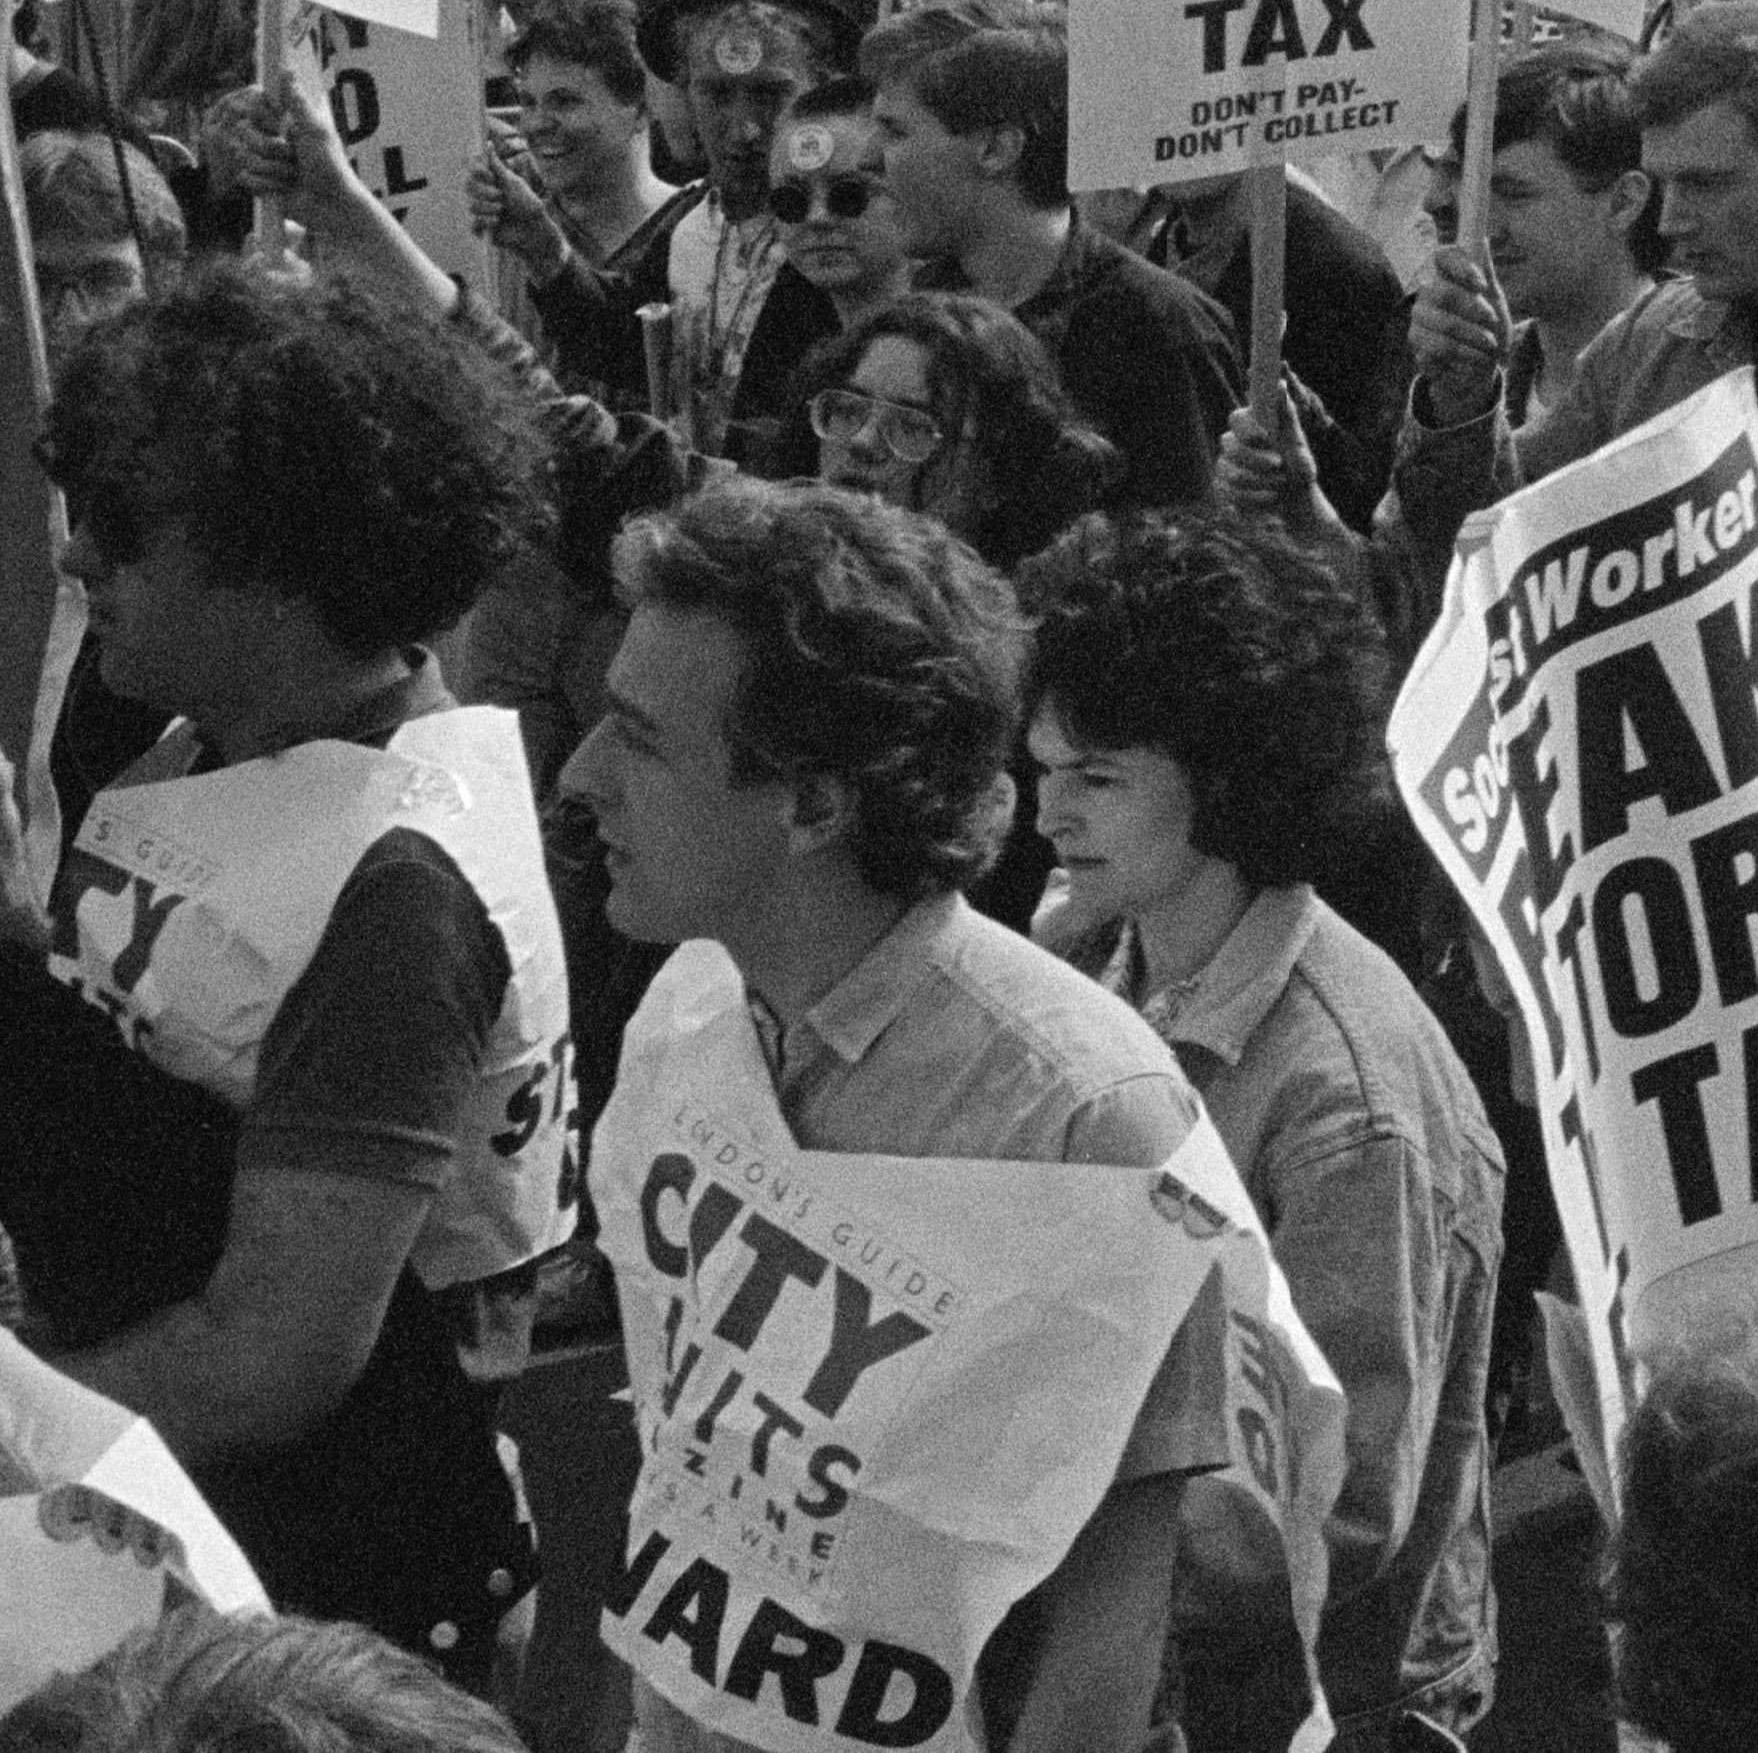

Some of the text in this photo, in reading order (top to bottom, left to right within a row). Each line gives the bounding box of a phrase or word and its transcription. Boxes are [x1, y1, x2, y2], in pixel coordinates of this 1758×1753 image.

[1155, 99, 1400, 163] DON'T COLLECT
[1191, 79, 1366, 126] DON'T PAY-
[640, 1150, 935, 1421] CITY
[830, 1220, 960, 1319] GUIDE
